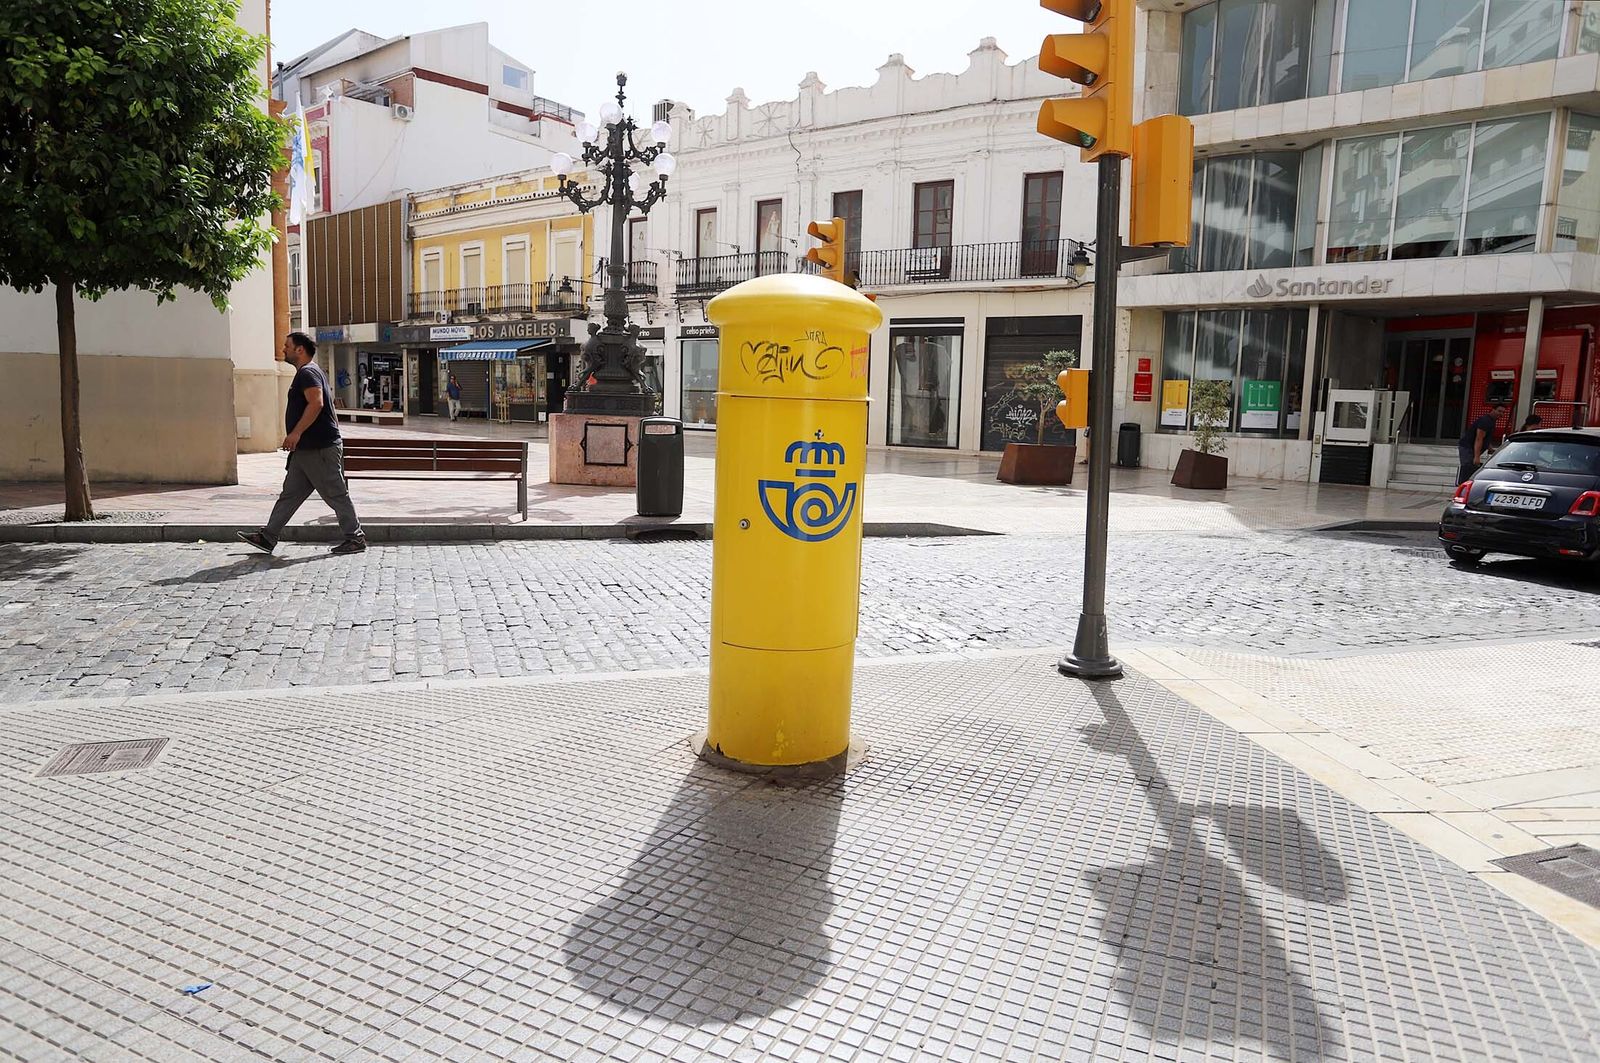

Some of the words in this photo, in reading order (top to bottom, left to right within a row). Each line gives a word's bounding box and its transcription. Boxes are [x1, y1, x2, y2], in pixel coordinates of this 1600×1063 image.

[1275, 274, 1394, 297] Santander
[473, 325, 495, 338] LOS
[500, 322, 557, 337] ANGELES
[686, 327, 699, 335] celso
[700, 326, 716, 336] prieto
[1494, 495, 1520, 504] 4236
[1521, 497, 1543, 507] LFD
